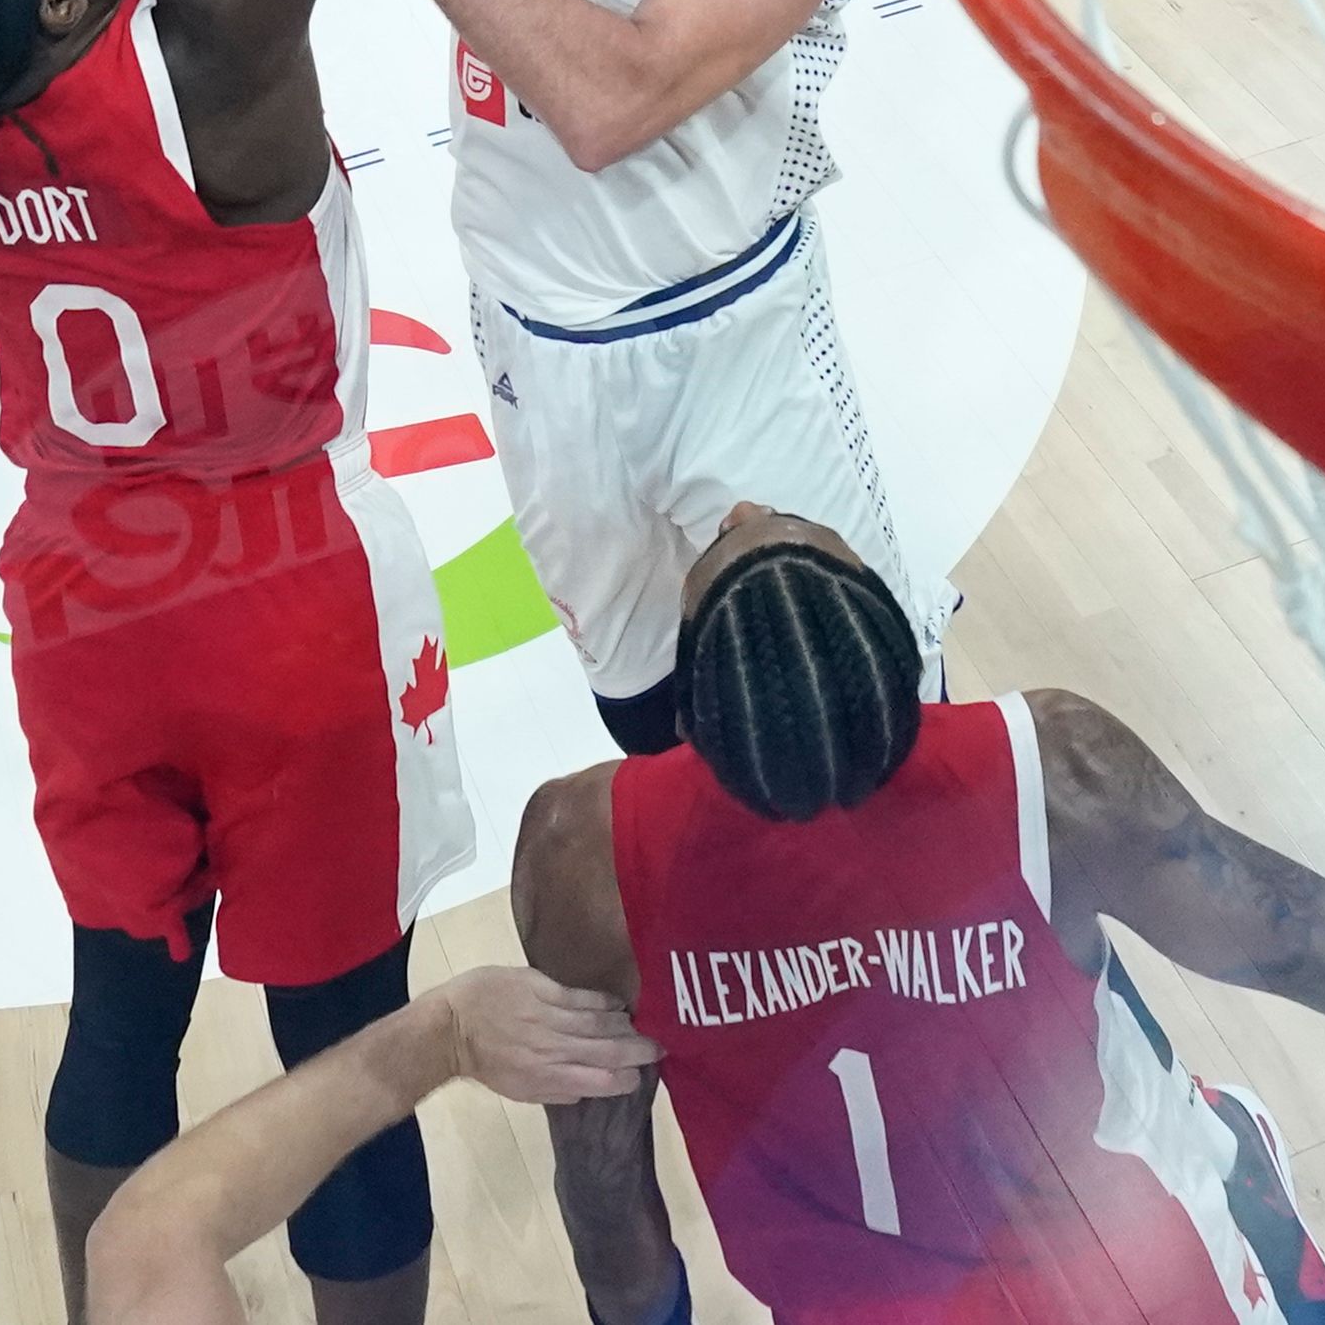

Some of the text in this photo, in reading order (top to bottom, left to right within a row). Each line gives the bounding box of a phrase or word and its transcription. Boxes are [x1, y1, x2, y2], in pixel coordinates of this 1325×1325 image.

[29, 283, 167, 447] 0
[670, 919, 1027, 1028] ALEXANDER-WALKER
[828, 1047, 901, 1237] 1
